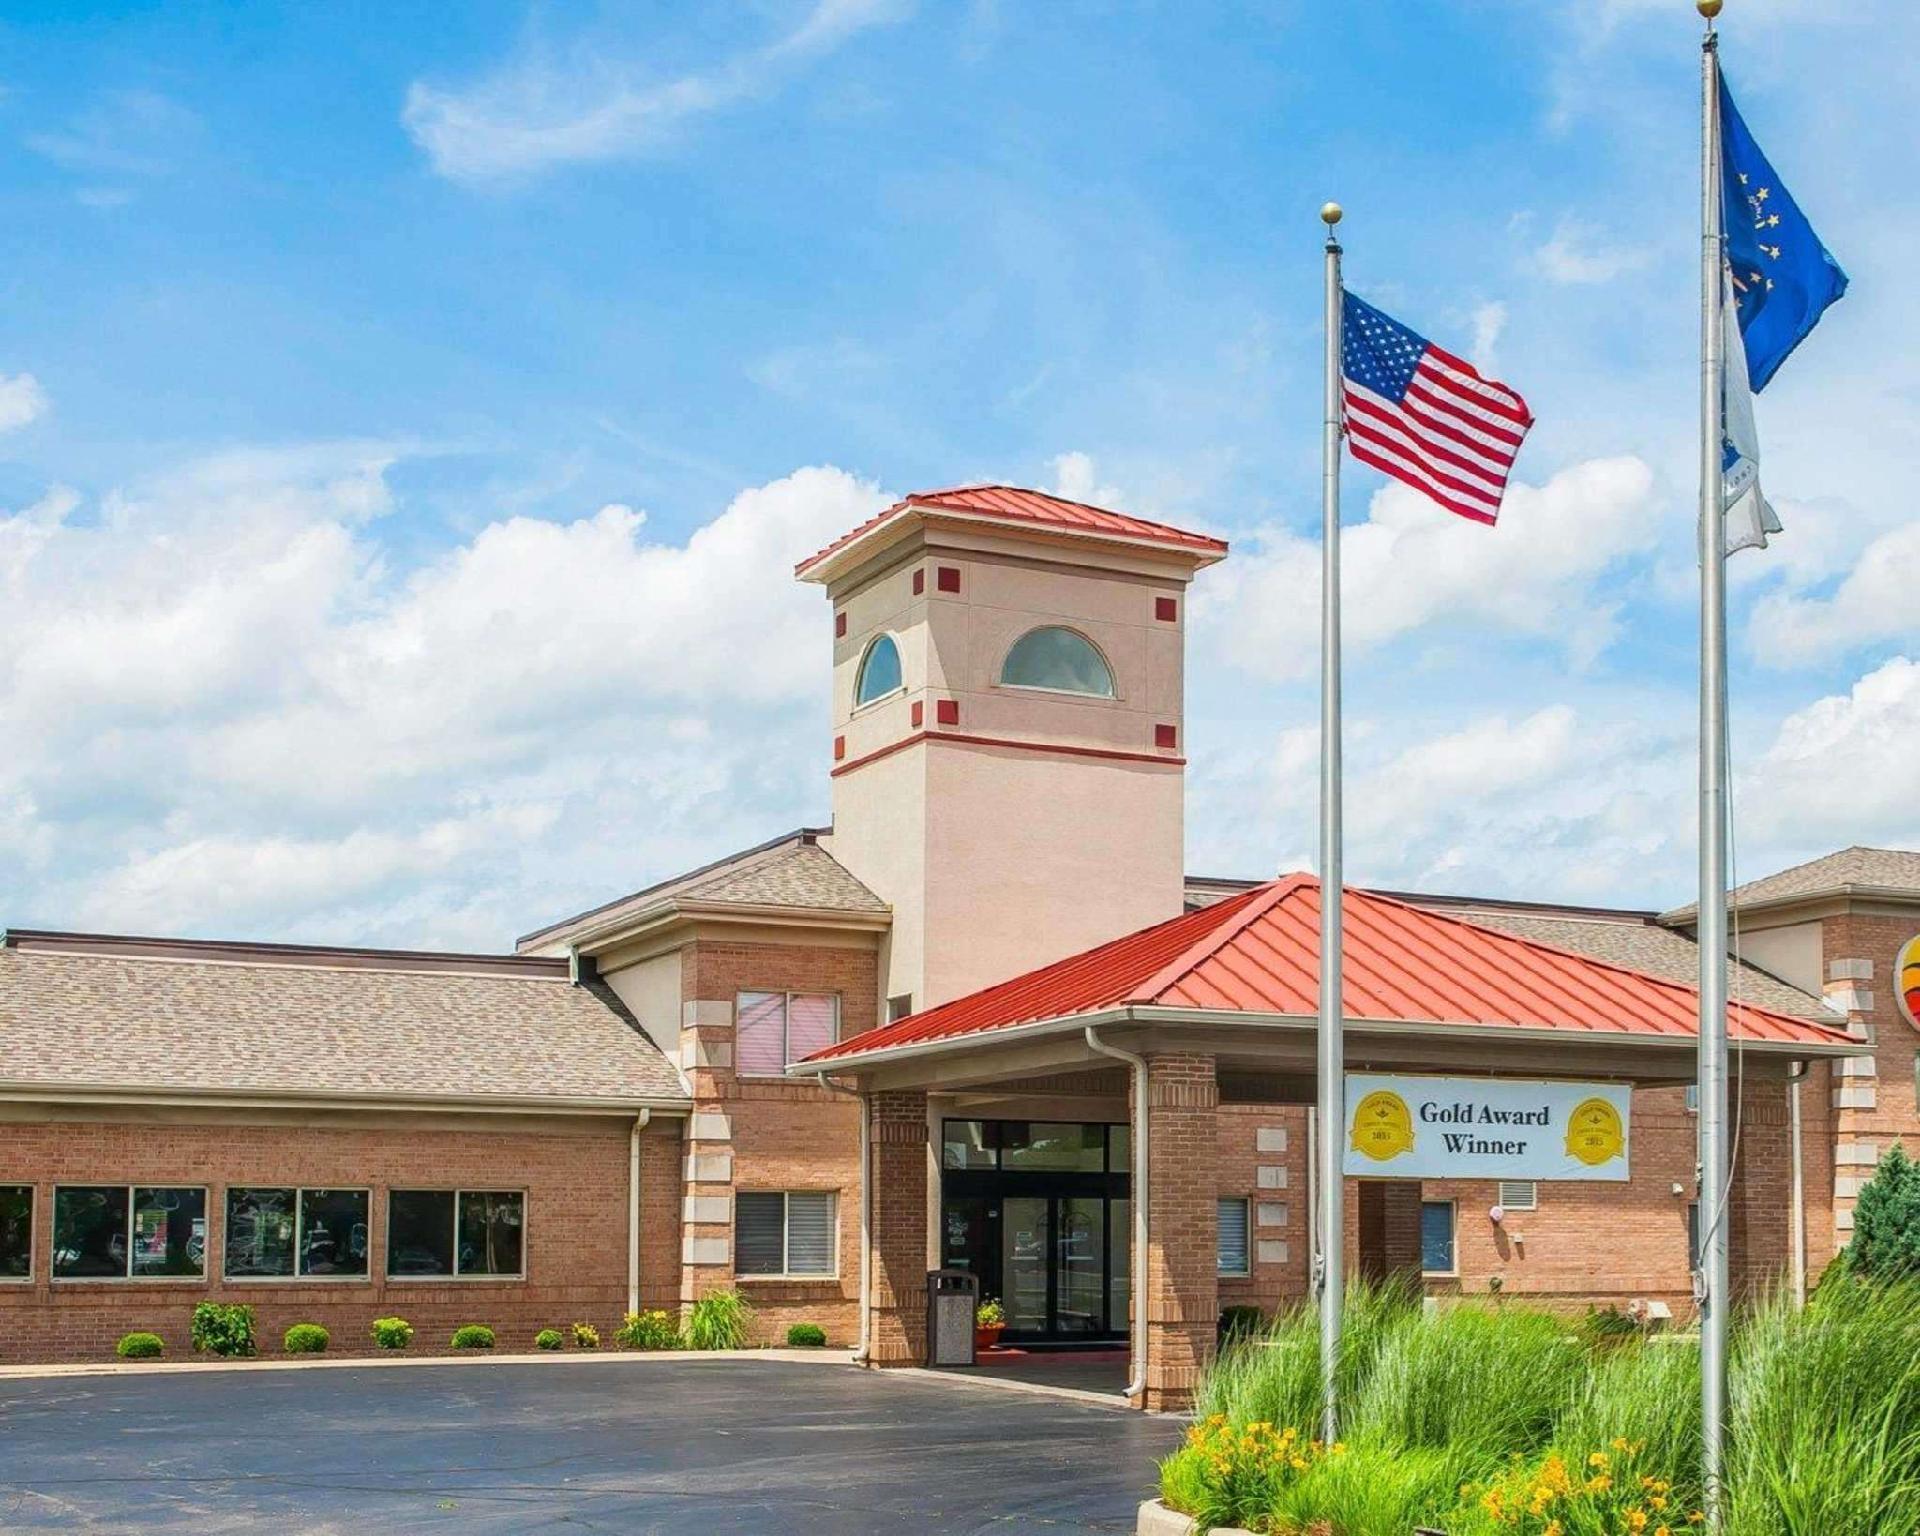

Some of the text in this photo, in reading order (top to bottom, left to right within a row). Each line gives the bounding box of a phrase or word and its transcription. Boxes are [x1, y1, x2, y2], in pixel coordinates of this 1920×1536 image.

[1420, 1102, 1473, 1124] Gold
[1477, 1104, 1550, 1126] Award
[1441, 1133, 1527, 1155] Winner
